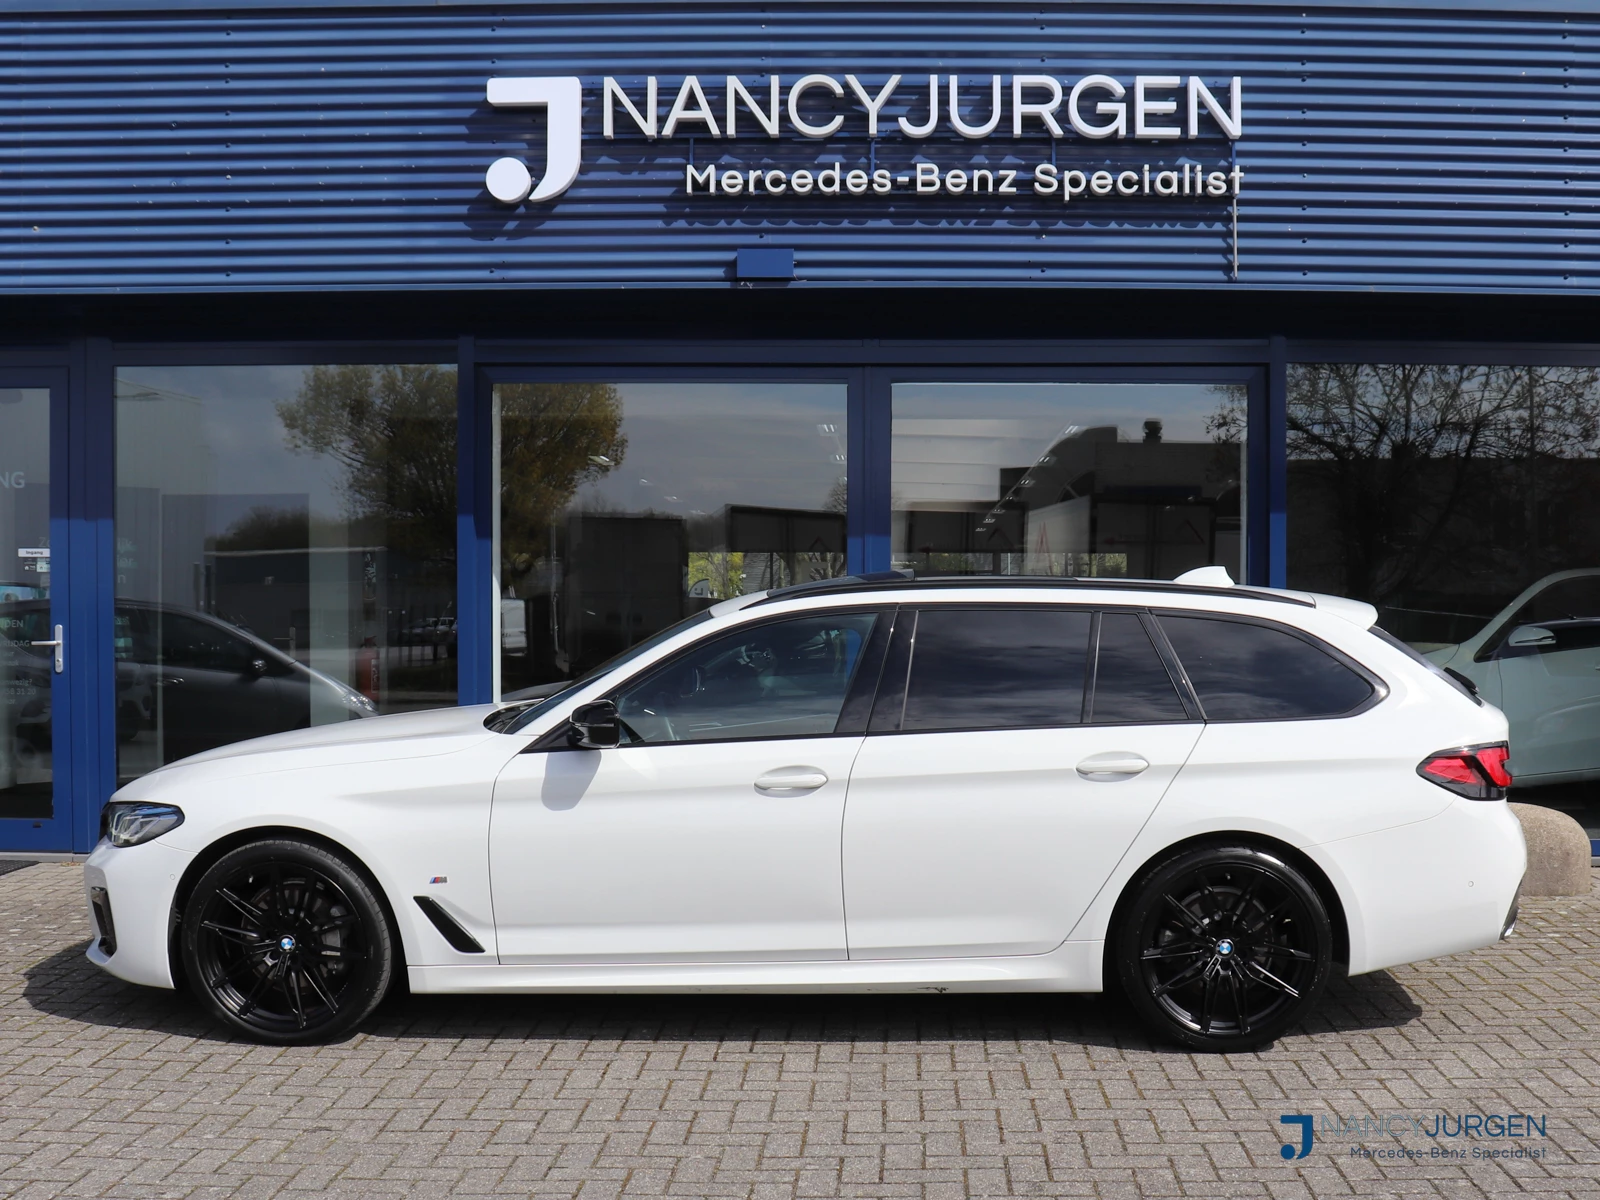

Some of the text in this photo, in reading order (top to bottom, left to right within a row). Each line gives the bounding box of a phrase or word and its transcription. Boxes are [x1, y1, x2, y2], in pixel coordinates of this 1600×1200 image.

[603, 74, 1242, 139] NANCYJURGEN
[686, 163, 1245, 203] Mercedes-Benz Specialist
